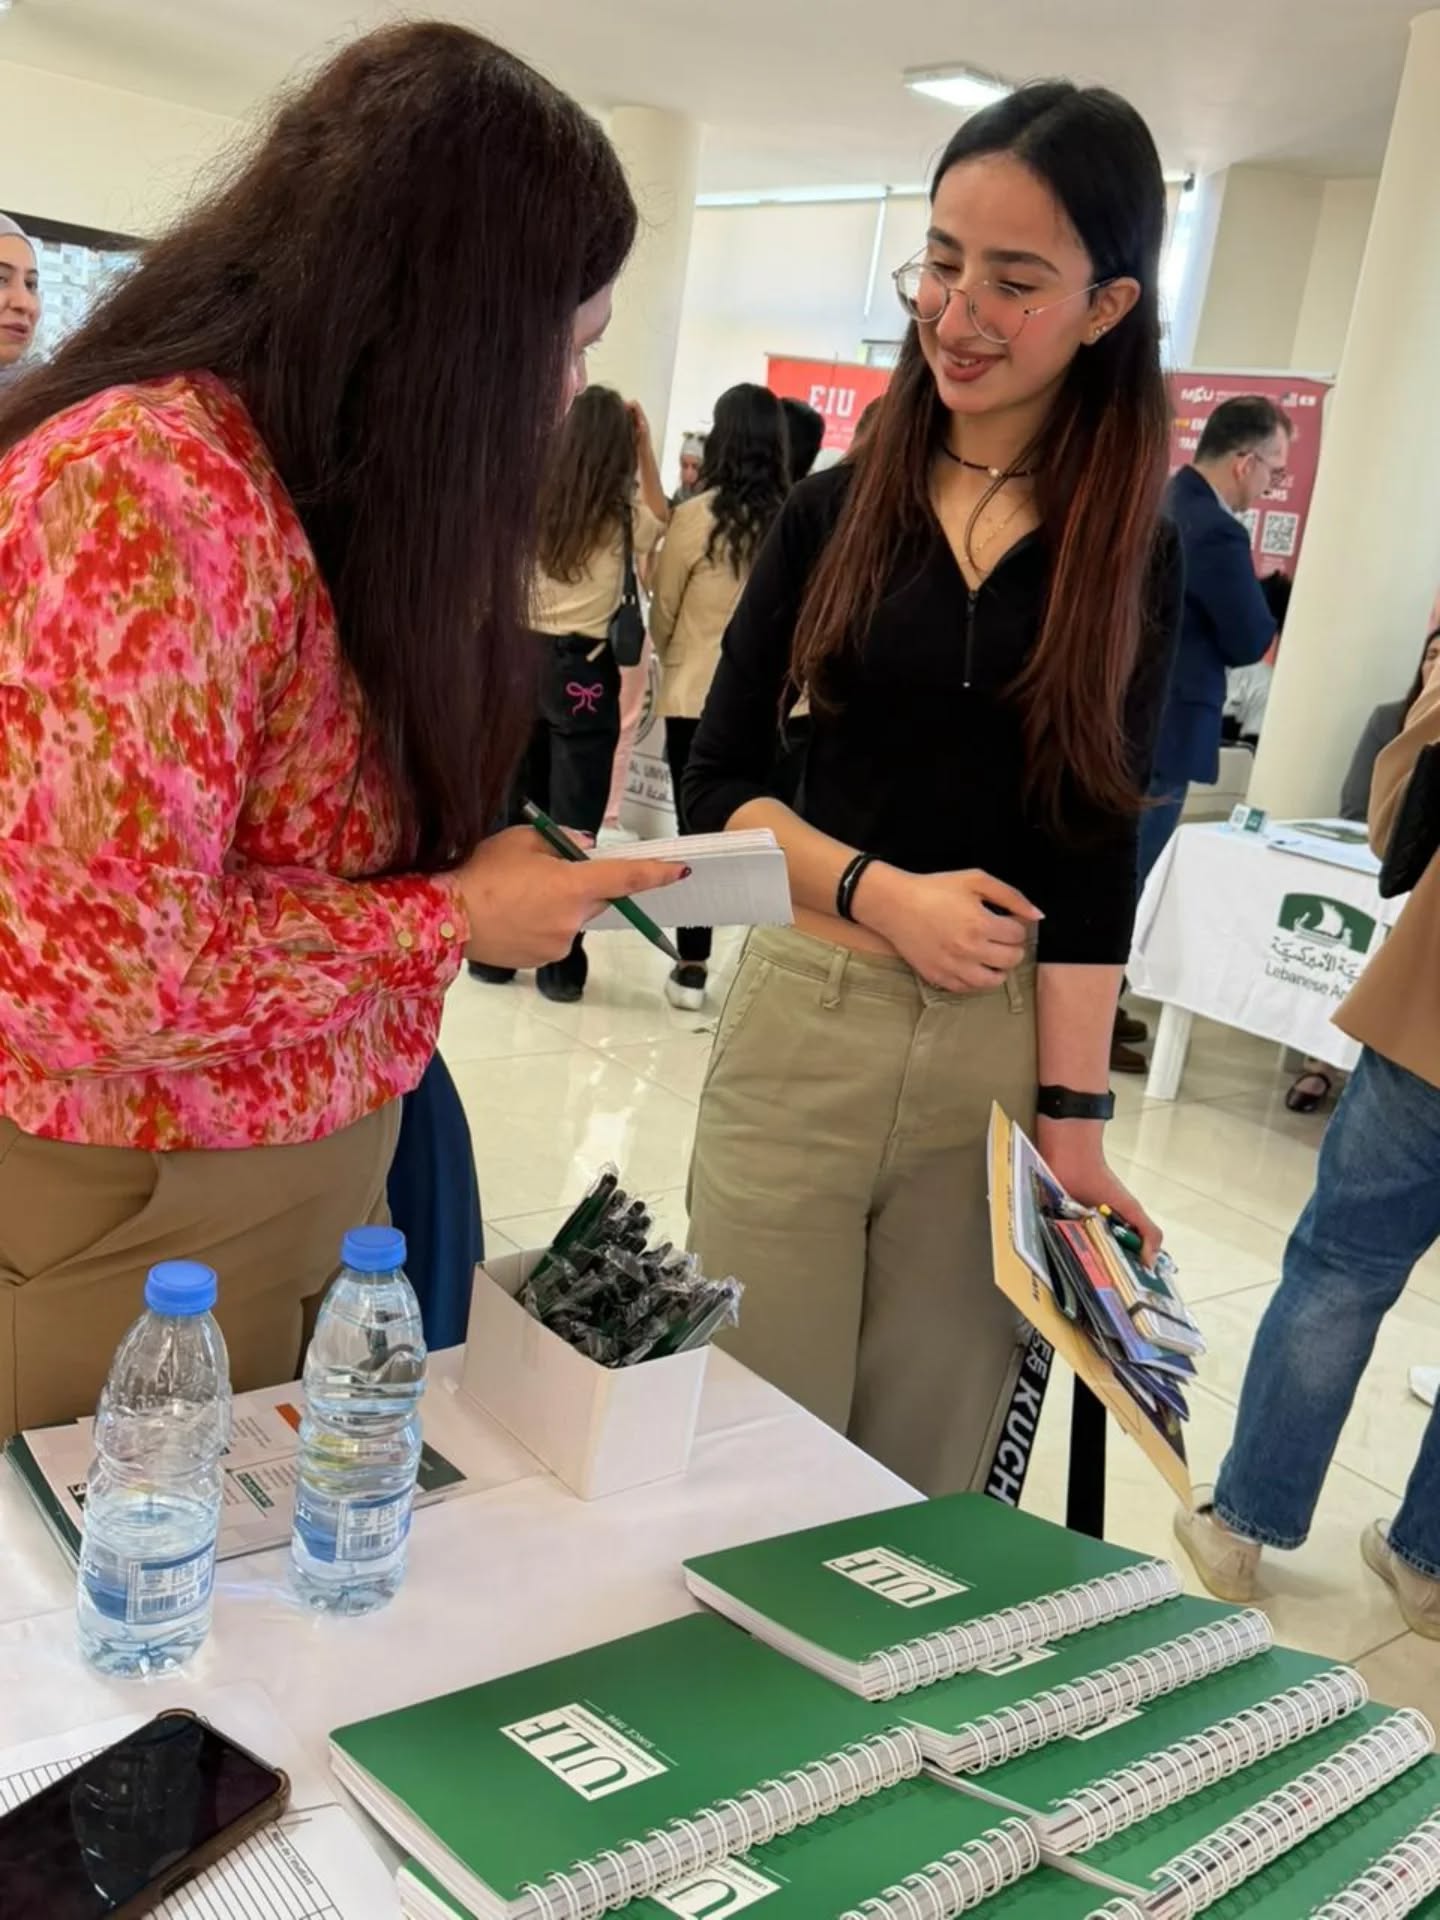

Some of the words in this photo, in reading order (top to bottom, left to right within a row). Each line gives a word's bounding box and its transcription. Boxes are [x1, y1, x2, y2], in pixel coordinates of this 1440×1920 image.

[1264, 963, 1329, 994] Lebanese
[831, 1557, 937, 1604] ULF
[508, 1720, 629, 1794] ULF
